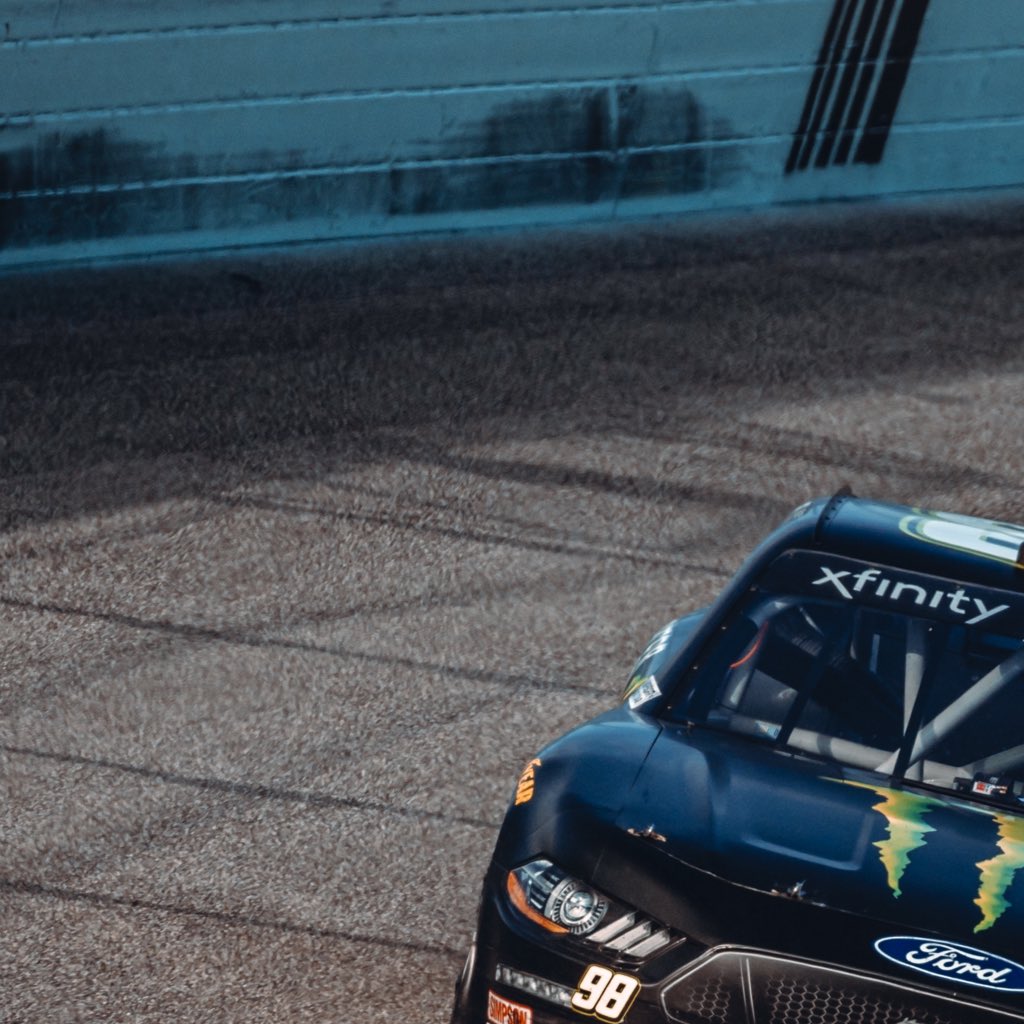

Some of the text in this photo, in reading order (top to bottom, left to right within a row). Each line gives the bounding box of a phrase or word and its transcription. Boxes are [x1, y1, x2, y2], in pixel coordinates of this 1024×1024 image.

[811, 566, 1010, 624] xfinity
[906, 942, 1012, 984] Ford
[571, 964, 640, 1023] 98
